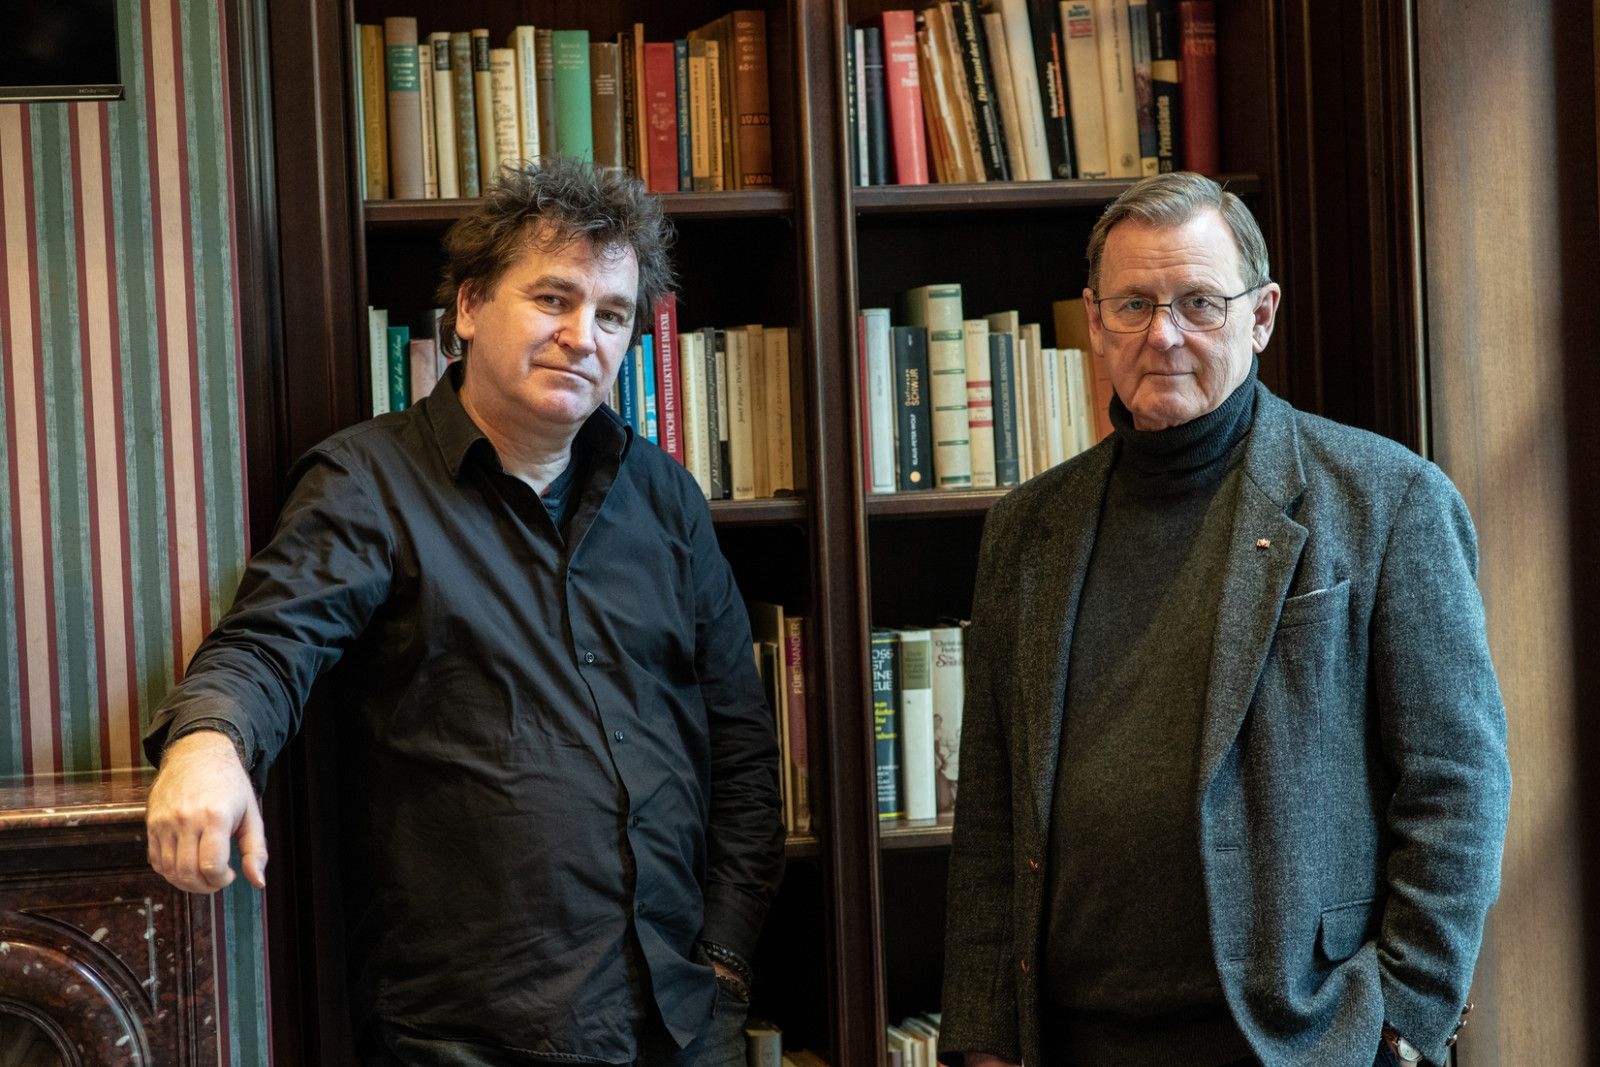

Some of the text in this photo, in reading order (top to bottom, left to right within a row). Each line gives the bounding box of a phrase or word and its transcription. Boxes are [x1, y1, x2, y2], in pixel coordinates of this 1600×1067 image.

[660, 312, 676, 453] DEUTSCHE INTELLEKTUELLE IM EXIL
[910, 368, 920, 407] SCHWUR
[791, 623, 803, 695] FÜREINANDER
[872, 649, 894, 660] OSS
[872, 660, 885, 671] ST
[873, 670, 893, 680] INE
[873, 681, 894, 691] EUE
